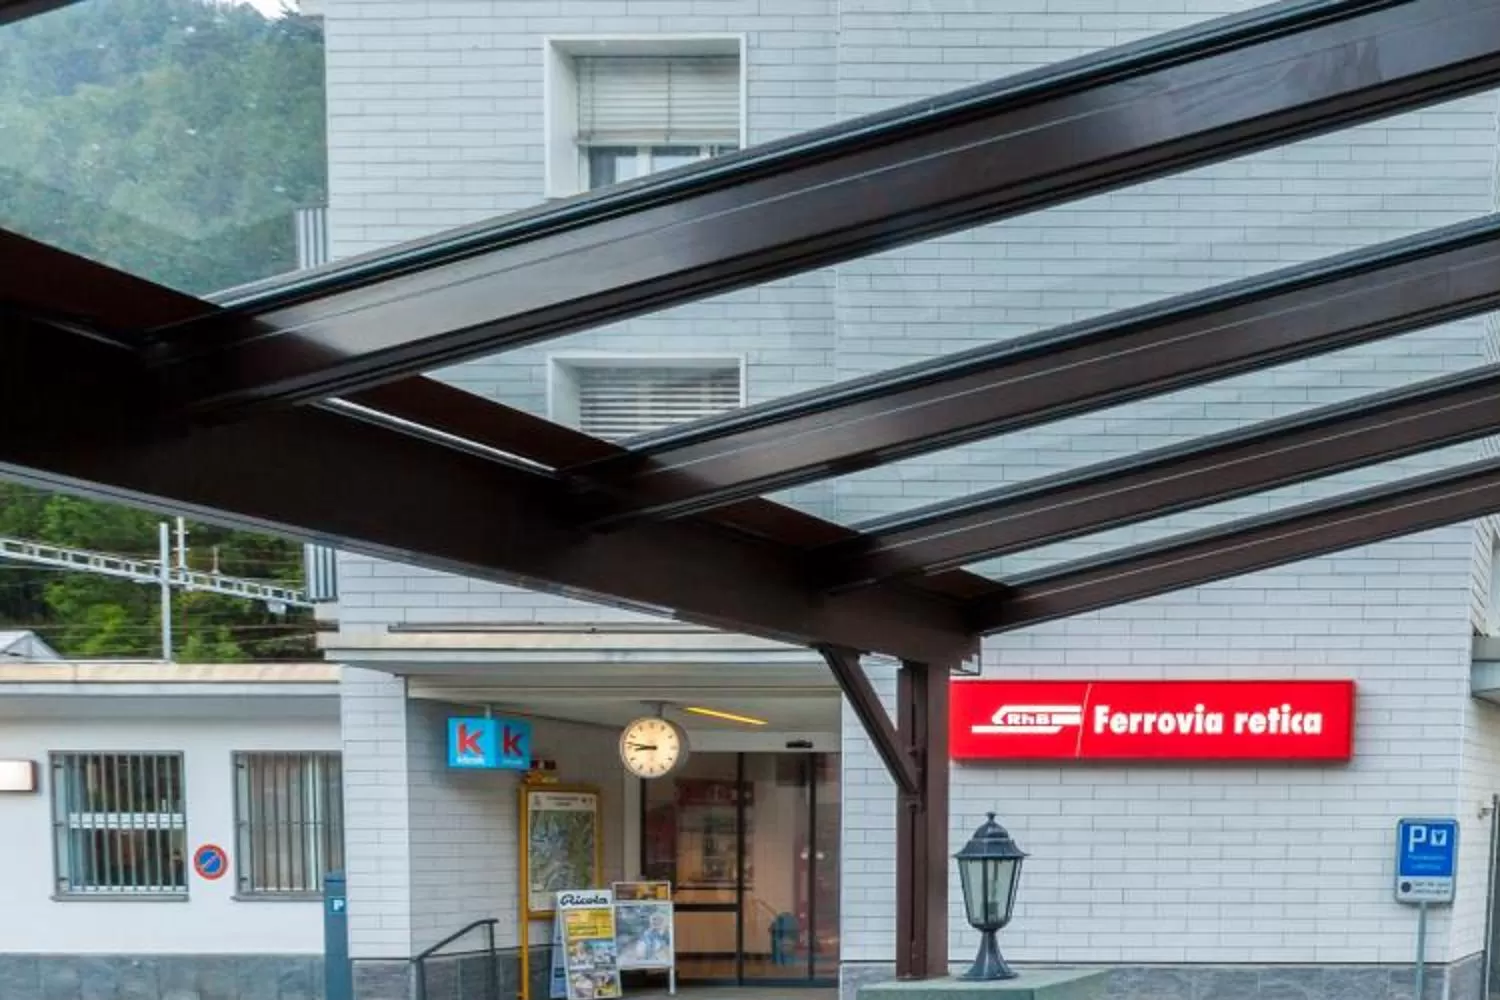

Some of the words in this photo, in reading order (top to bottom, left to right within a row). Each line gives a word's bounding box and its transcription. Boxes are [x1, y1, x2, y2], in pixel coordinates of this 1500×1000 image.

[1007, 712, 1049, 726] RhB
[1094, 703, 1223, 734] Ferrovia
[1234, 703, 1322, 734] retica
[1408, 825, 1427, 852] P
[333, 899, 345, 911] P
[560, 894, 609, 906] Ricola
